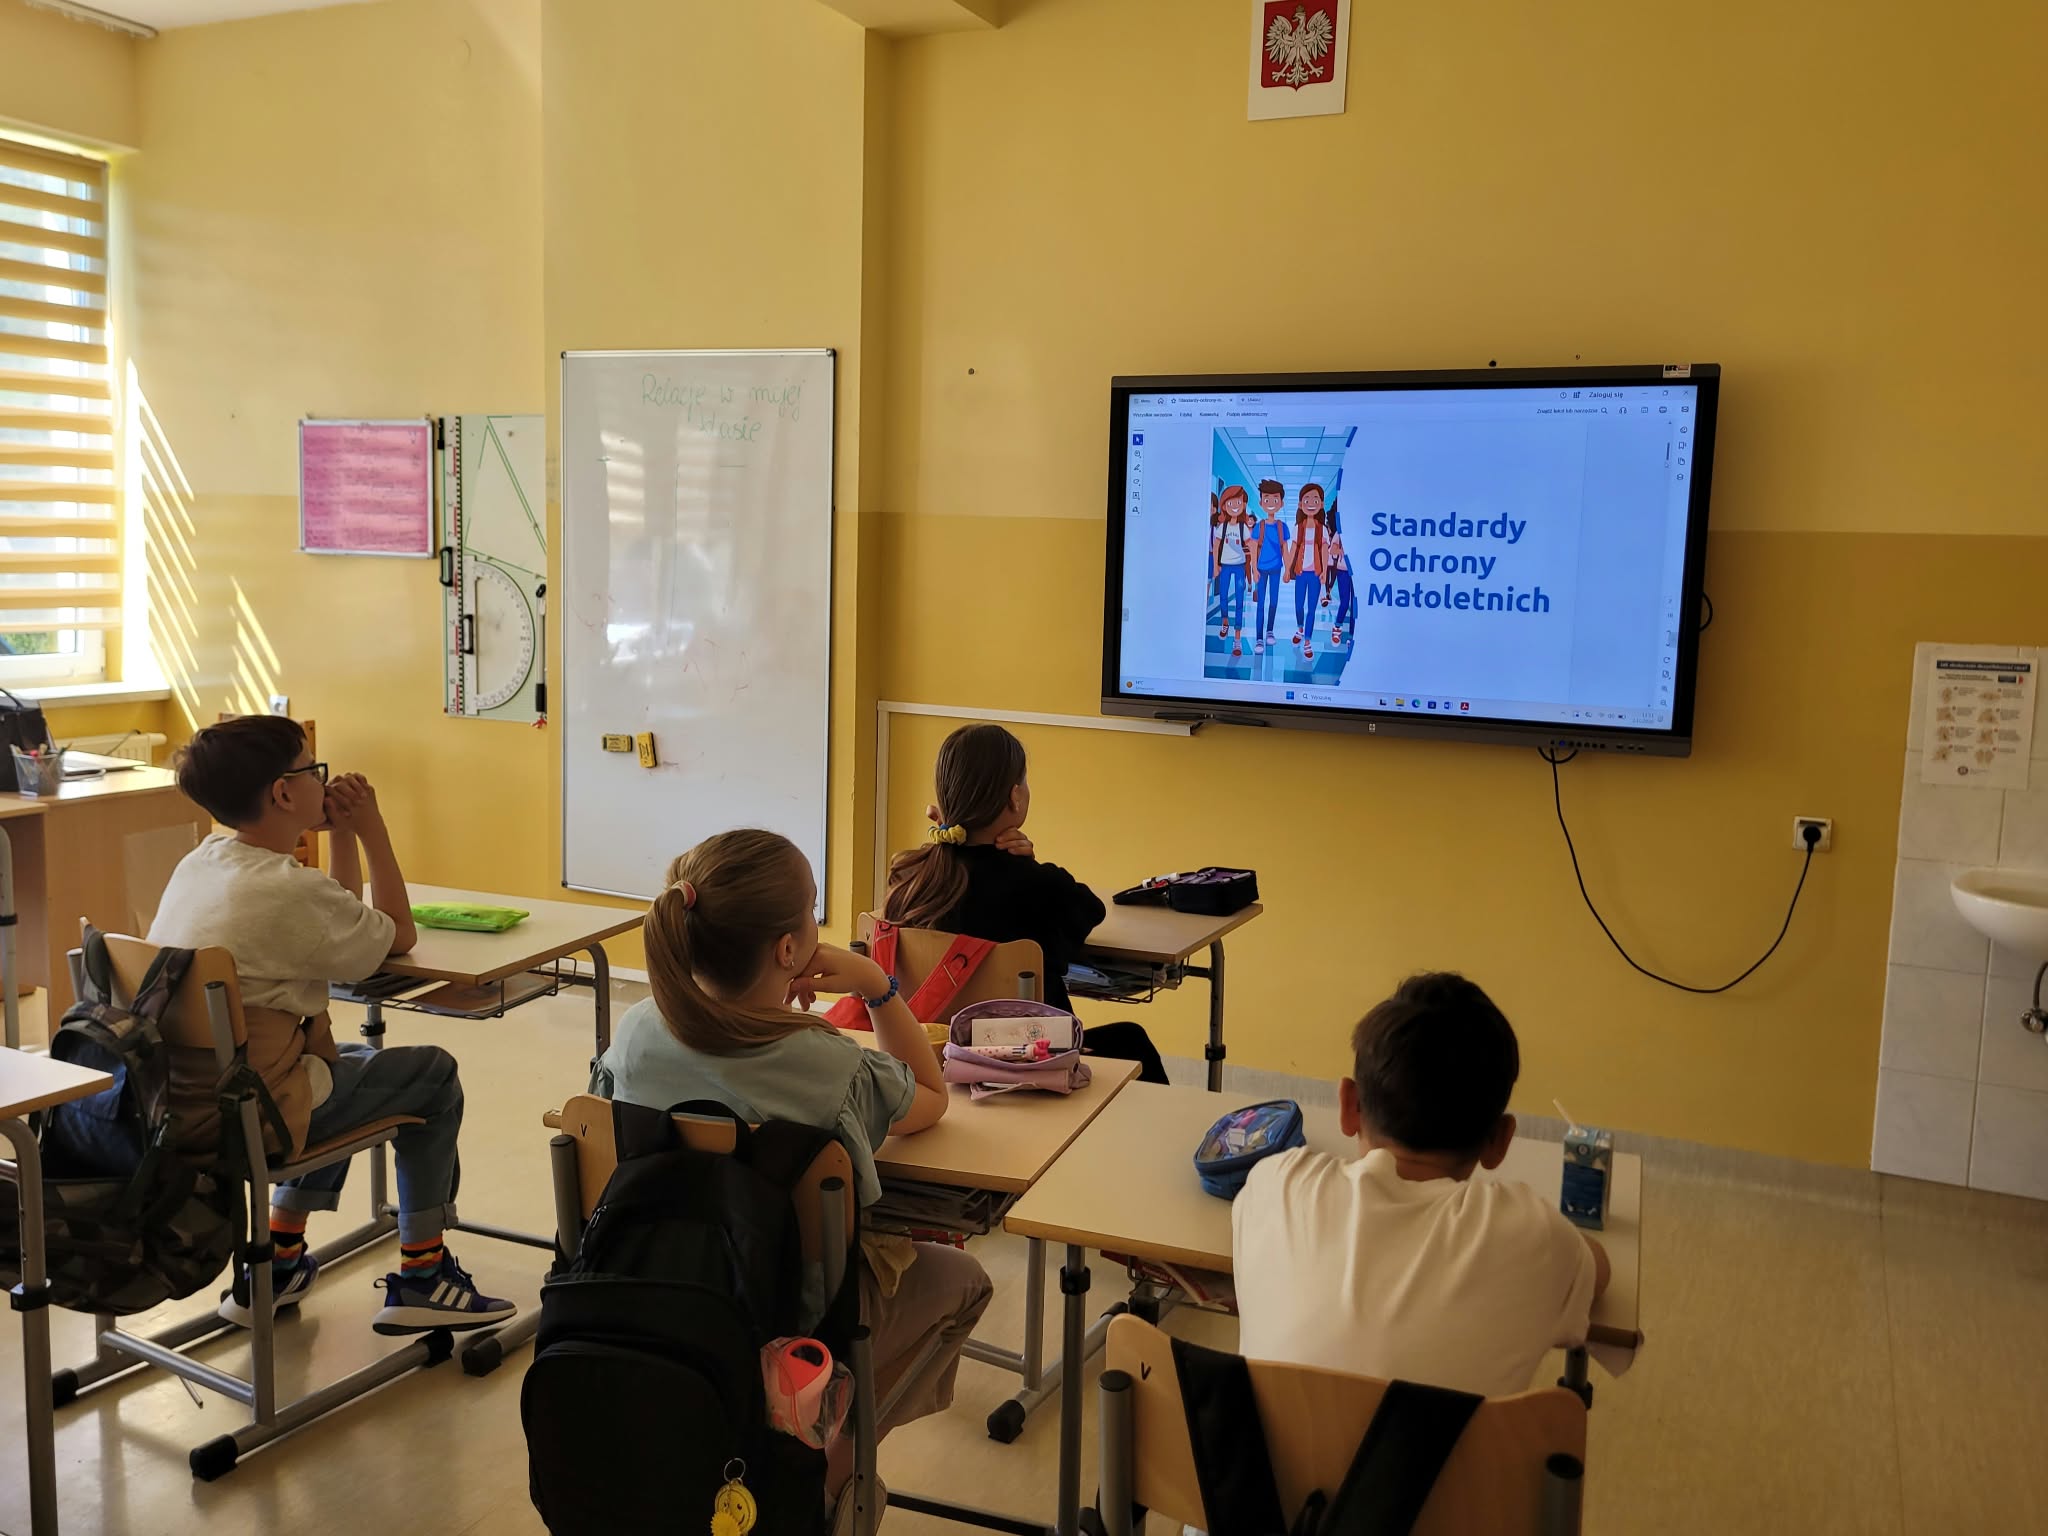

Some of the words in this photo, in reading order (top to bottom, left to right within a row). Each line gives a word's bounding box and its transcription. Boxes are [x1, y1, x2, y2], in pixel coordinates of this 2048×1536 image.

[641, 373, 706, 422] Relacje
[719, 385, 736, 404] w
[1588, 391, 1613, 399] Zaloguj
[1370, 511, 1527, 545] Standardy
[1369, 546, 1497, 580] Ochrony
[1367, 582, 1550, 613] Małoletnich
